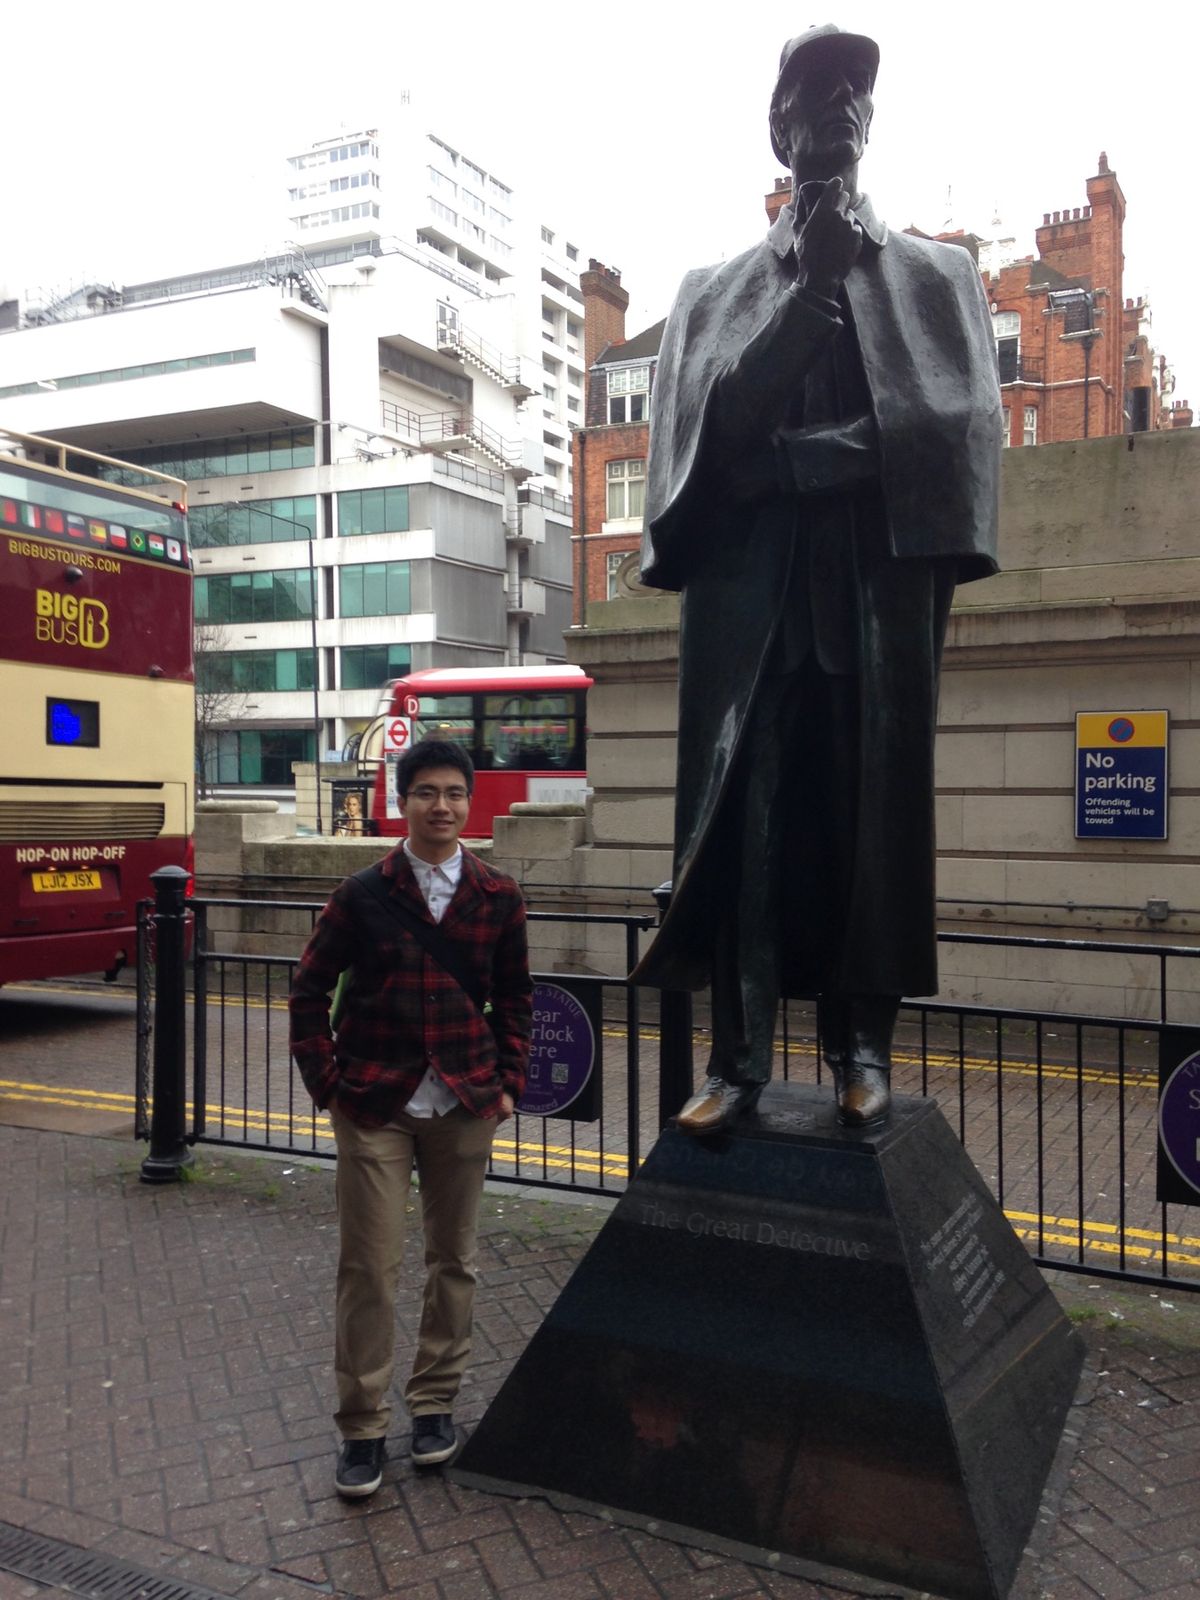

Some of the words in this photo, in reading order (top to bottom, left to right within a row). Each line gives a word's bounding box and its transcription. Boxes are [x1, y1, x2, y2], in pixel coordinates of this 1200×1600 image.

[8, 539, 121, 574] BIGBUSTOURS.COM
[36, 588, 79, 621] BIG
[36, 616, 79, 646] BUS
[407, 698, 419, 714] D
[1085, 752, 1115, 768] No
[1085, 773, 1156, 793] parking
[1085, 797, 1131, 807] Offending
[1085, 807, 1121, 815] vehicles
[1124, 807, 1140, 815] will
[1143, 807, 1155, 816] be
[1085, 816, 1114, 824] towed
[16, 847, 70, 863] HOP-ON
[72, 845, 127, 861] HOP-OFF
[40, 874, 69, 889] LJ12
[71, 873, 95, 887] JSX
[531, 1009, 561, 1023] ear
[528, 1044, 558, 1059] ere
[640, 1201, 681, 1230] The
[686, 1211, 748, 1241] Great
[756, 1222, 872, 1261] Detective
